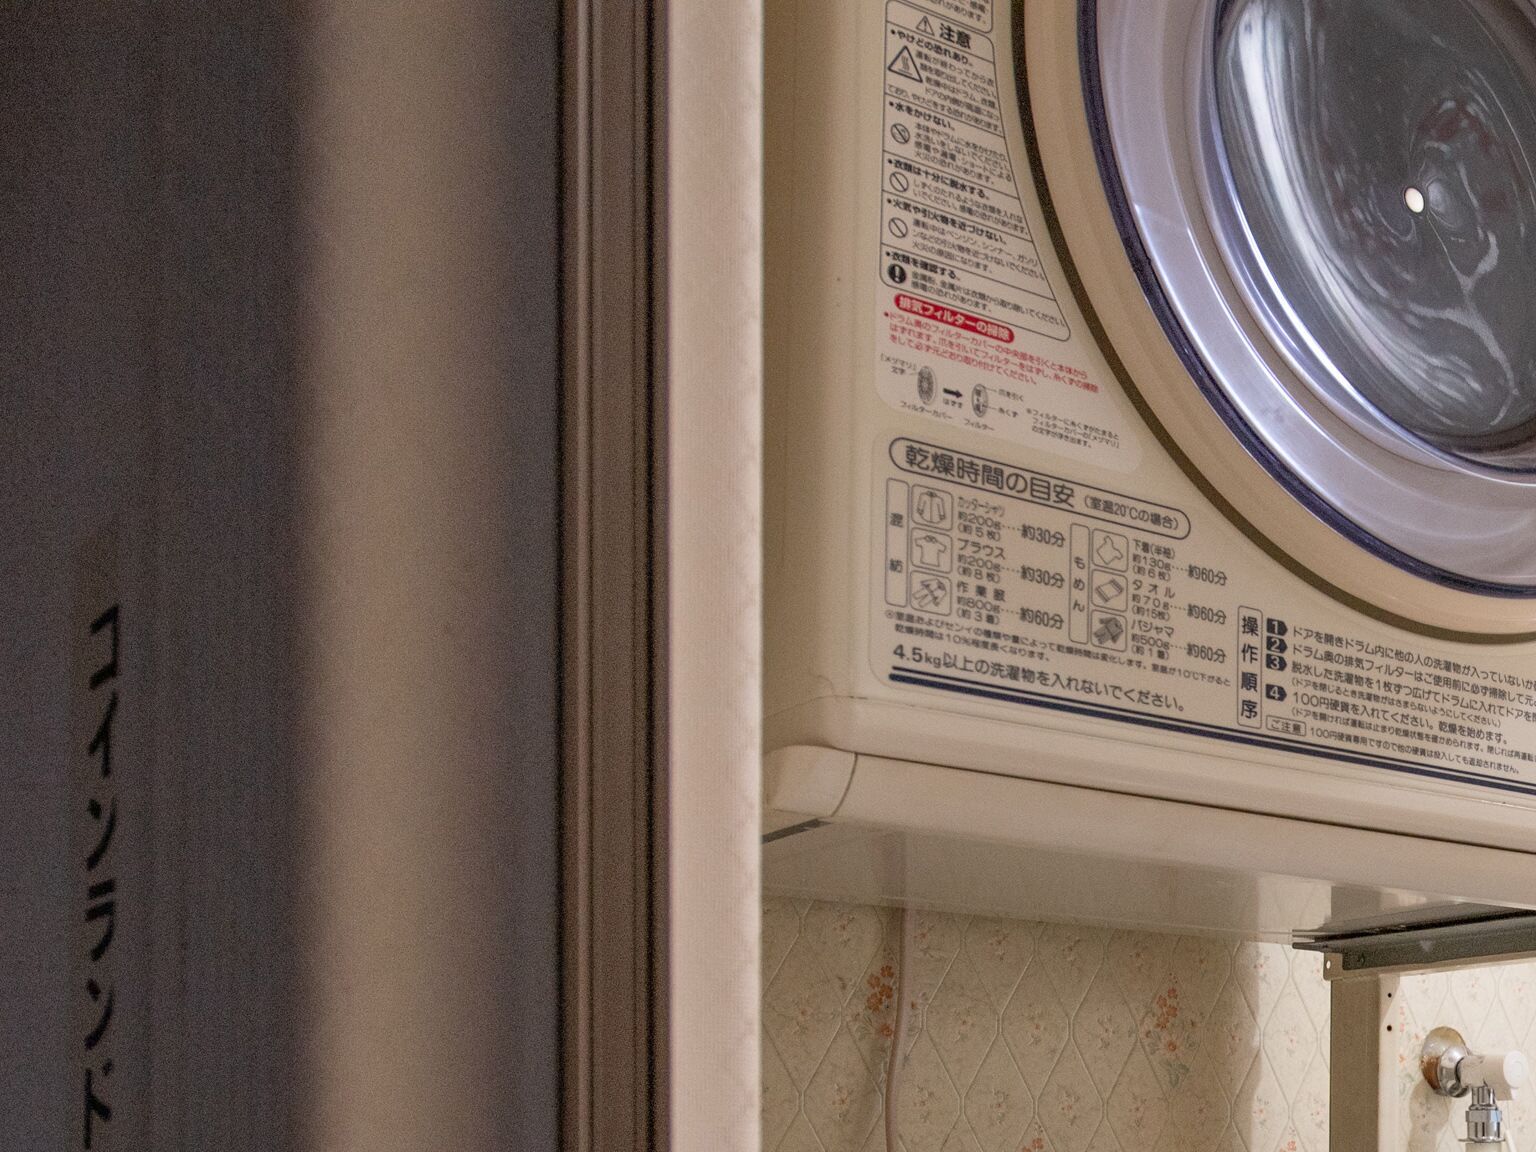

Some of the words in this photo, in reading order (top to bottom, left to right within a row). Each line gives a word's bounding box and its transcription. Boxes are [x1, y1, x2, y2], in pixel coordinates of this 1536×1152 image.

[897, 29, 973, 66] やけどの恐れあり。
[940, 23, 971, 49] 注意
[895, 102, 955, 131] 水をかけない。
[894, 159, 990, 200] 衣類は十分に脱水する。
[893, 199, 1006, 245] 火気や引火物を近づけない。
[891, 252, 961, 281] 衣類を確認する。
[901, 295, 1010, 339] 排気フィルターの掃除
[905, 444, 1075, 508] 乾燥時間の目安
[957, 538, 1006, 560] ブラウス
[1073, 556, 1086, 613] もめん
[1132, 579, 1175, 599] タオル
[1131, 620, 1174, 638] パジャマ
[893, 644, 1184, 712] 4.5kg以上の洗濯物を入れないでください。
[1241, 616, 1259, 719] 操作順序
[1271, 719, 1301, 735] ご注意
[1293, 691, 1507, 744] 100円硬貨を入れてください。乾燥を始めます。
